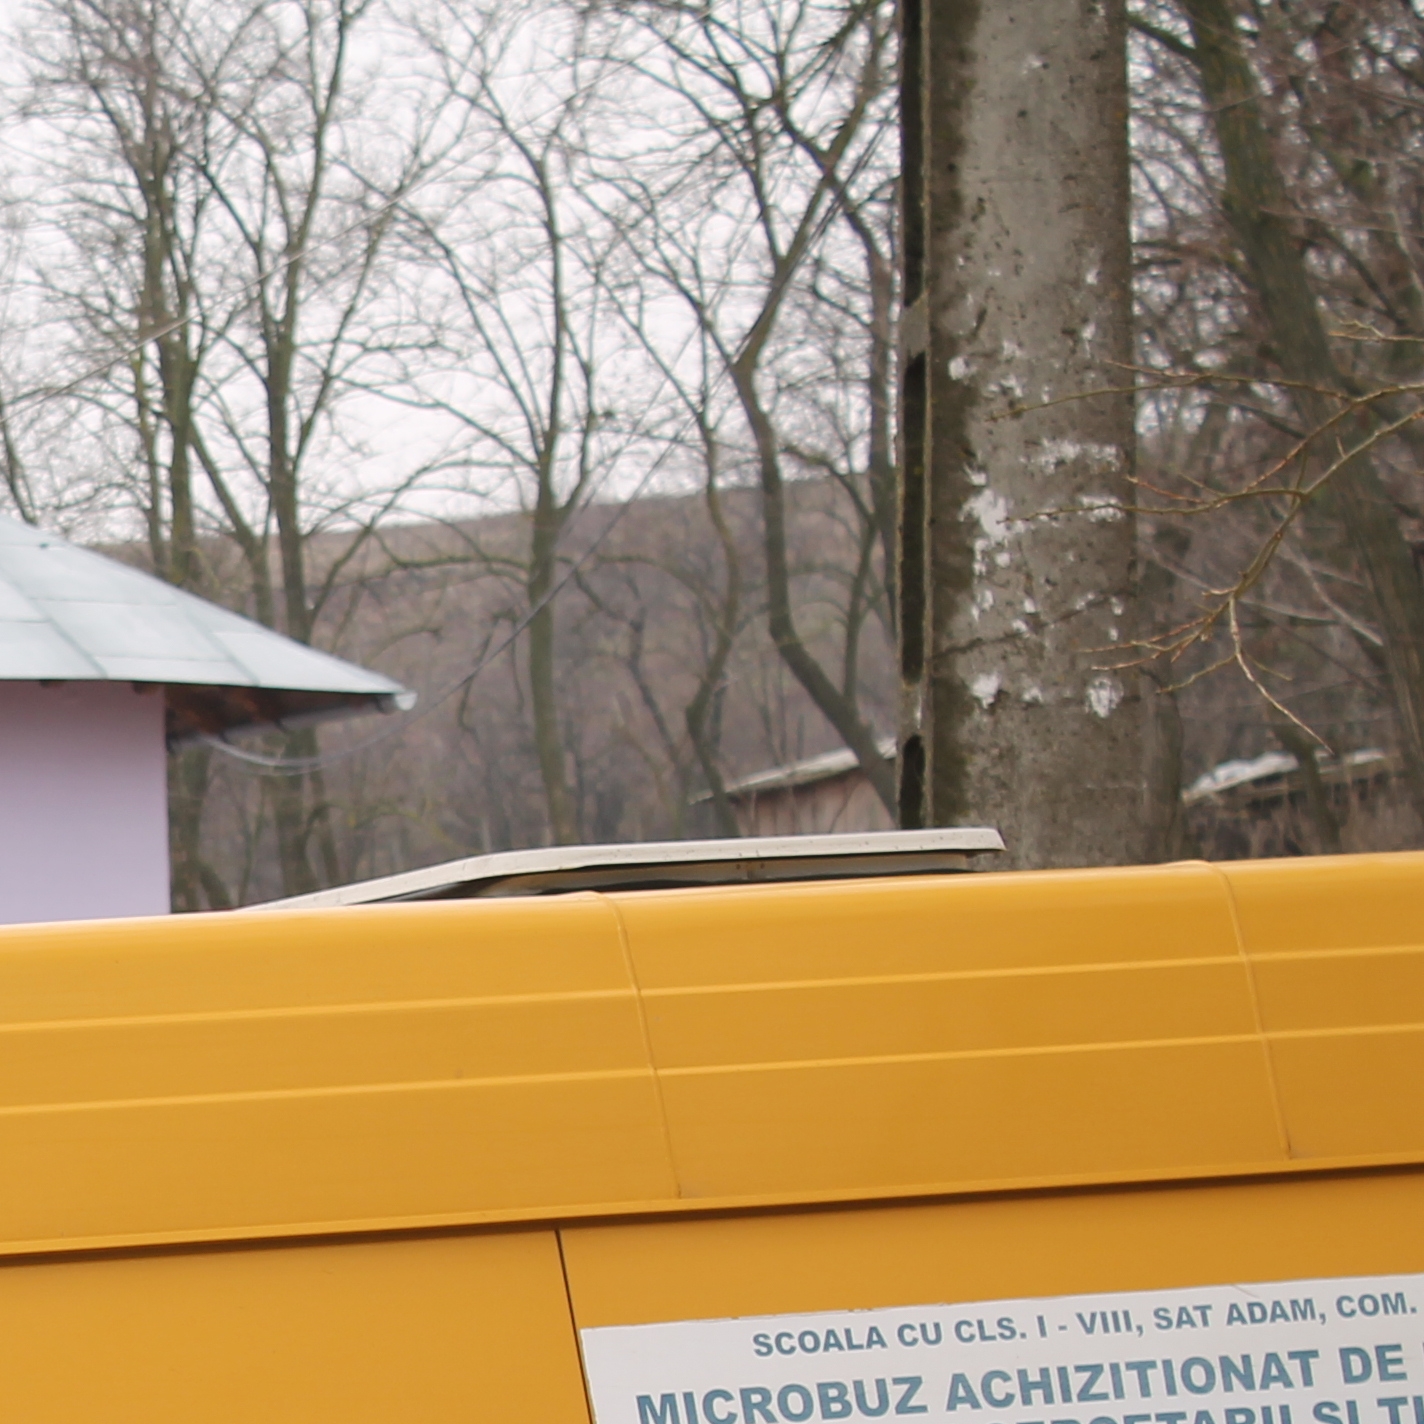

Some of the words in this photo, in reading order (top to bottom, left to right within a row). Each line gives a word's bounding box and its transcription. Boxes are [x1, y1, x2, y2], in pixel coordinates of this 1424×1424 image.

[752, 1326, 888, 1358] SCOALA
[896, 1321, 943, 1347] CU
[953, 1316, 1028, 1344] CLS.
[1036, 1314, 1048, 1339] I
[1076, 1309, 1145, 1337] VIII,
[1153, 1304, 1214, 1331] SAT
[1225, 1297, 1328, 1326] ADAM,
[1335, 1291, 1418, 1319] COM.
[945, 1349, 1321, 1413] ACHIZITIONAT
[1338, 1343, 1409, 1386] DE
